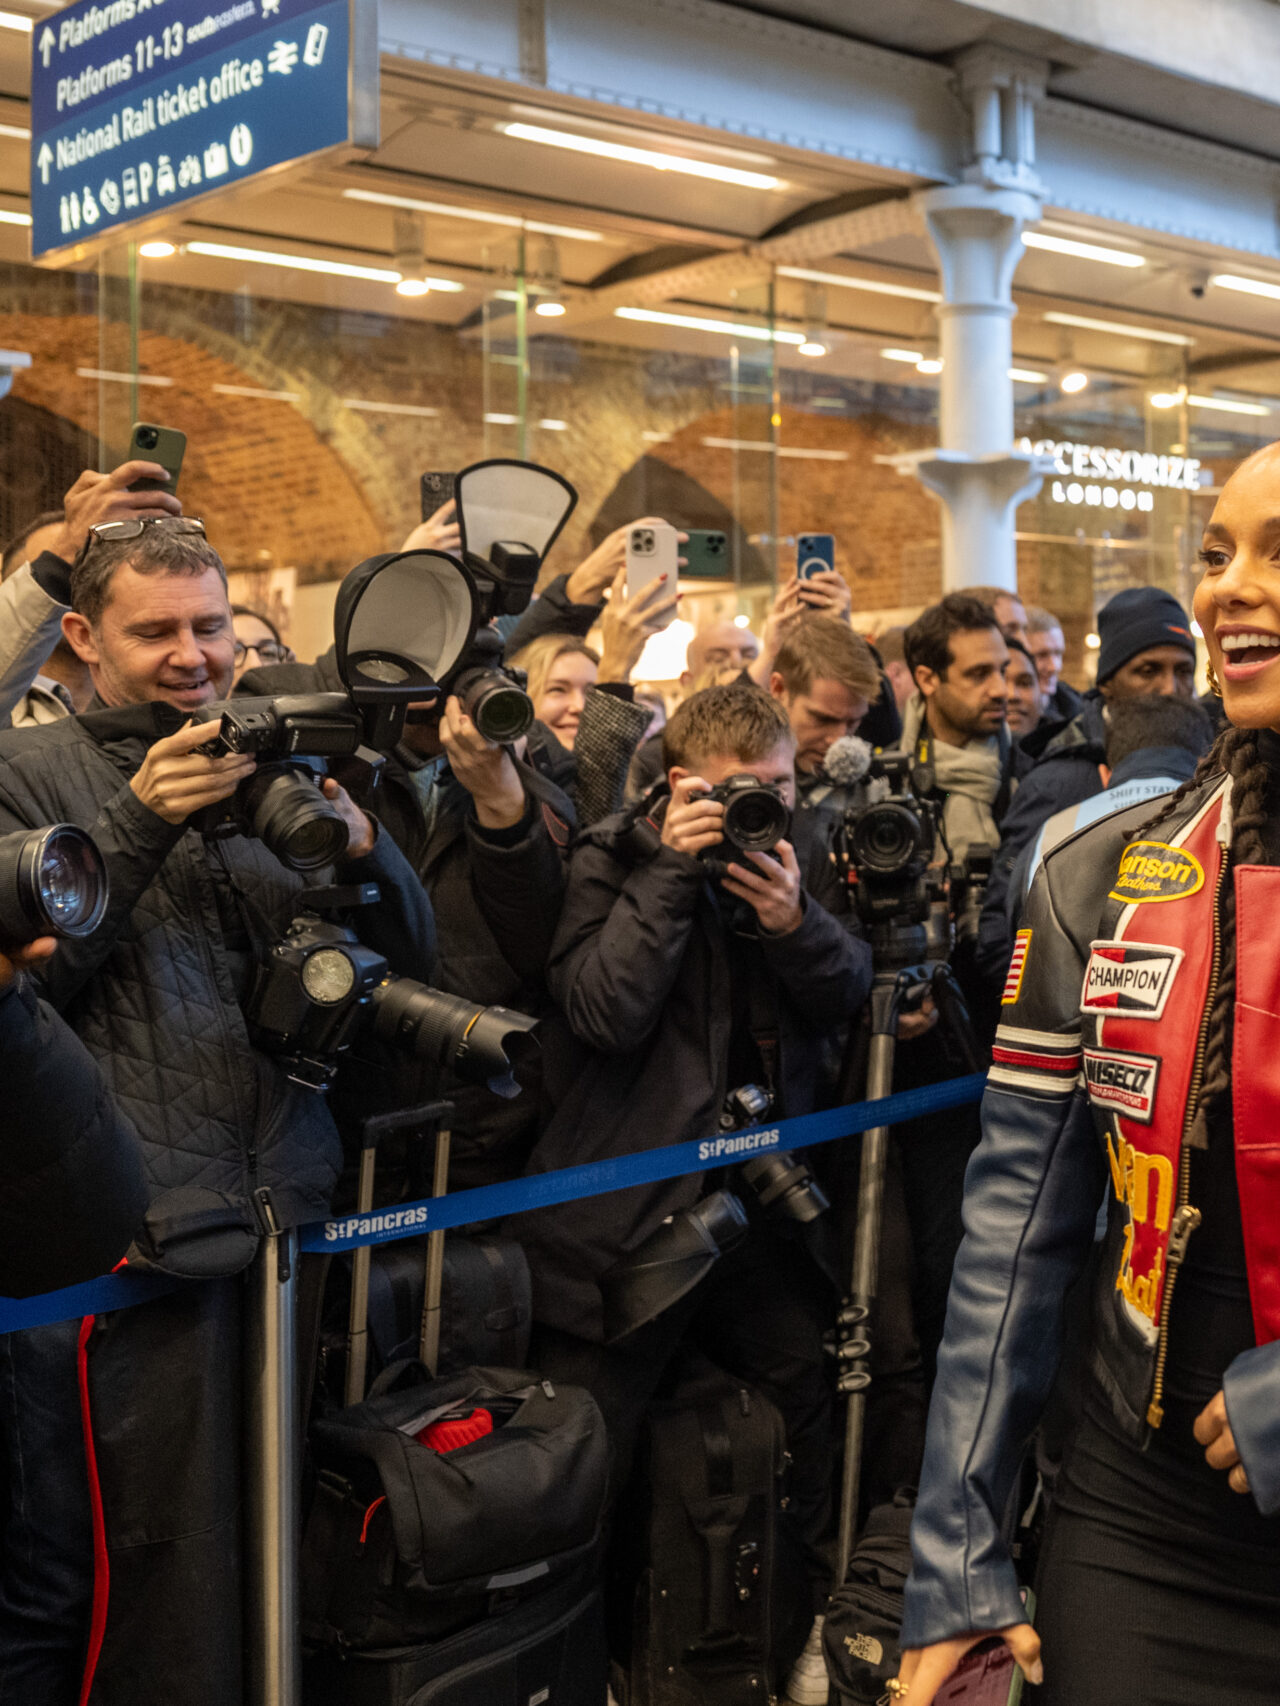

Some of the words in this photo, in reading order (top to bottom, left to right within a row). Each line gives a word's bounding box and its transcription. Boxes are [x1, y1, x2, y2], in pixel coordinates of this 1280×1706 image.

[59, 0, 136, 53] Platforms
[56, 54, 133, 112] Platforms
[135, 22, 184, 73] 11-13
[56, 114, 121, 171] National
[121, 97, 156, 142] Rail
[156, 76, 208, 126] ticket
[209, 58, 264, 104] office
[1052, 480, 1154, 512] LONDON
[1109, 785, 1141, 800] SHIFT
[1120, 855, 1192, 884] anson
[1089, 966, 1162, 990] CHAMPION
